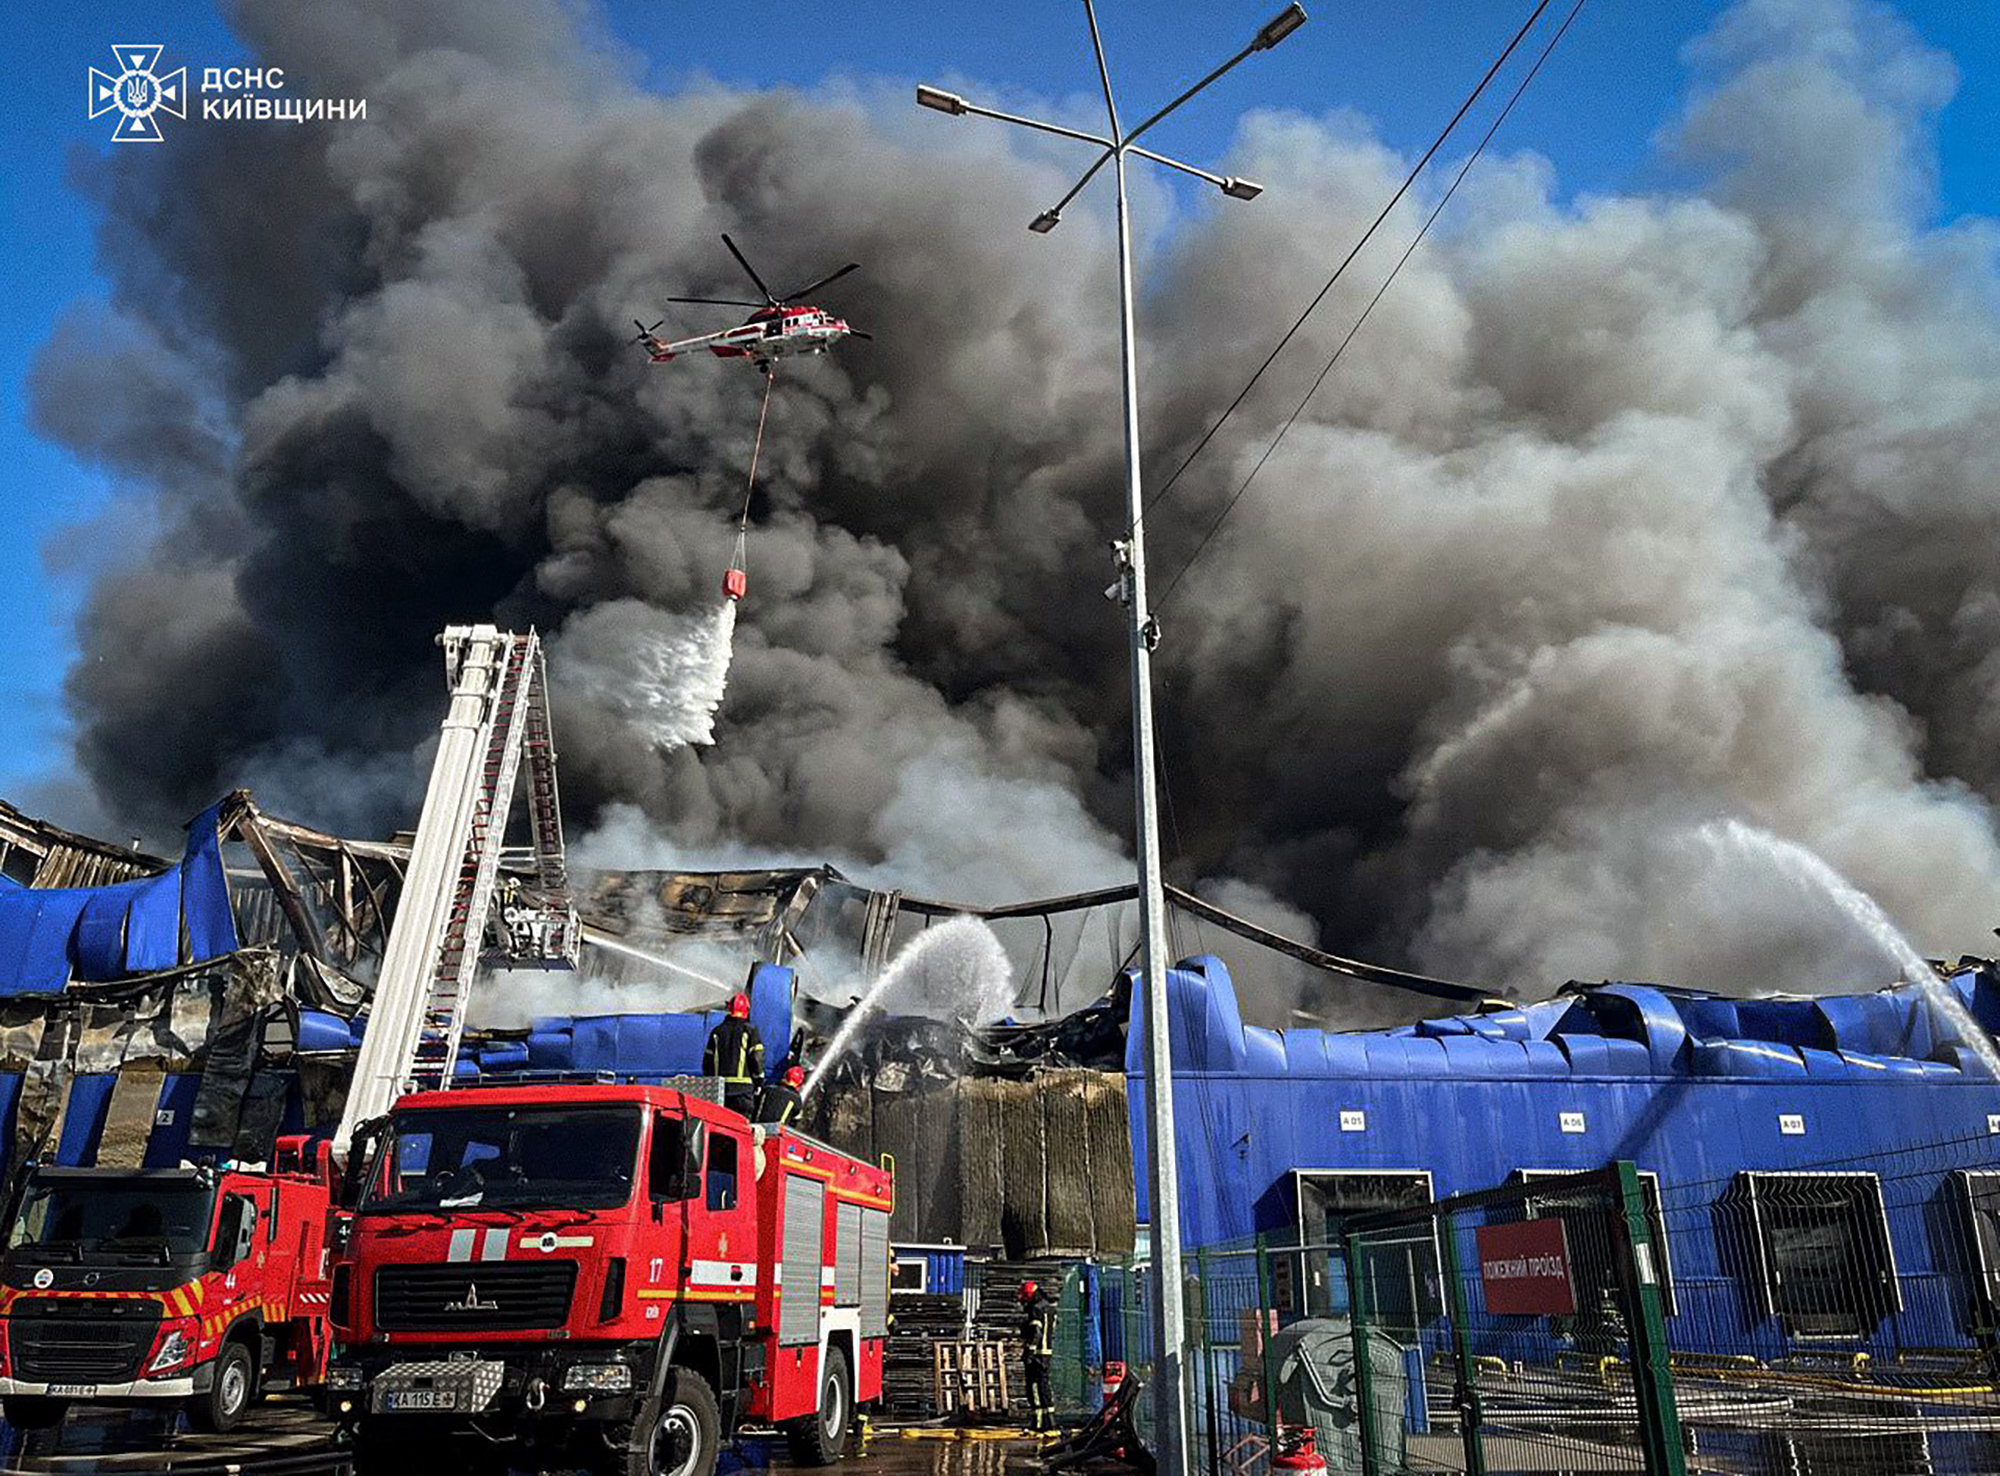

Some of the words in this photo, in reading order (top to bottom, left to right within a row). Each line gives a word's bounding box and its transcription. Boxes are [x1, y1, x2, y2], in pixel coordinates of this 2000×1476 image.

[649, 1258, 663, 1282] 17
[1528, 1252, 1565, 1279] ПРОЇЗД
[225, 1273, 237, 1289] 44
